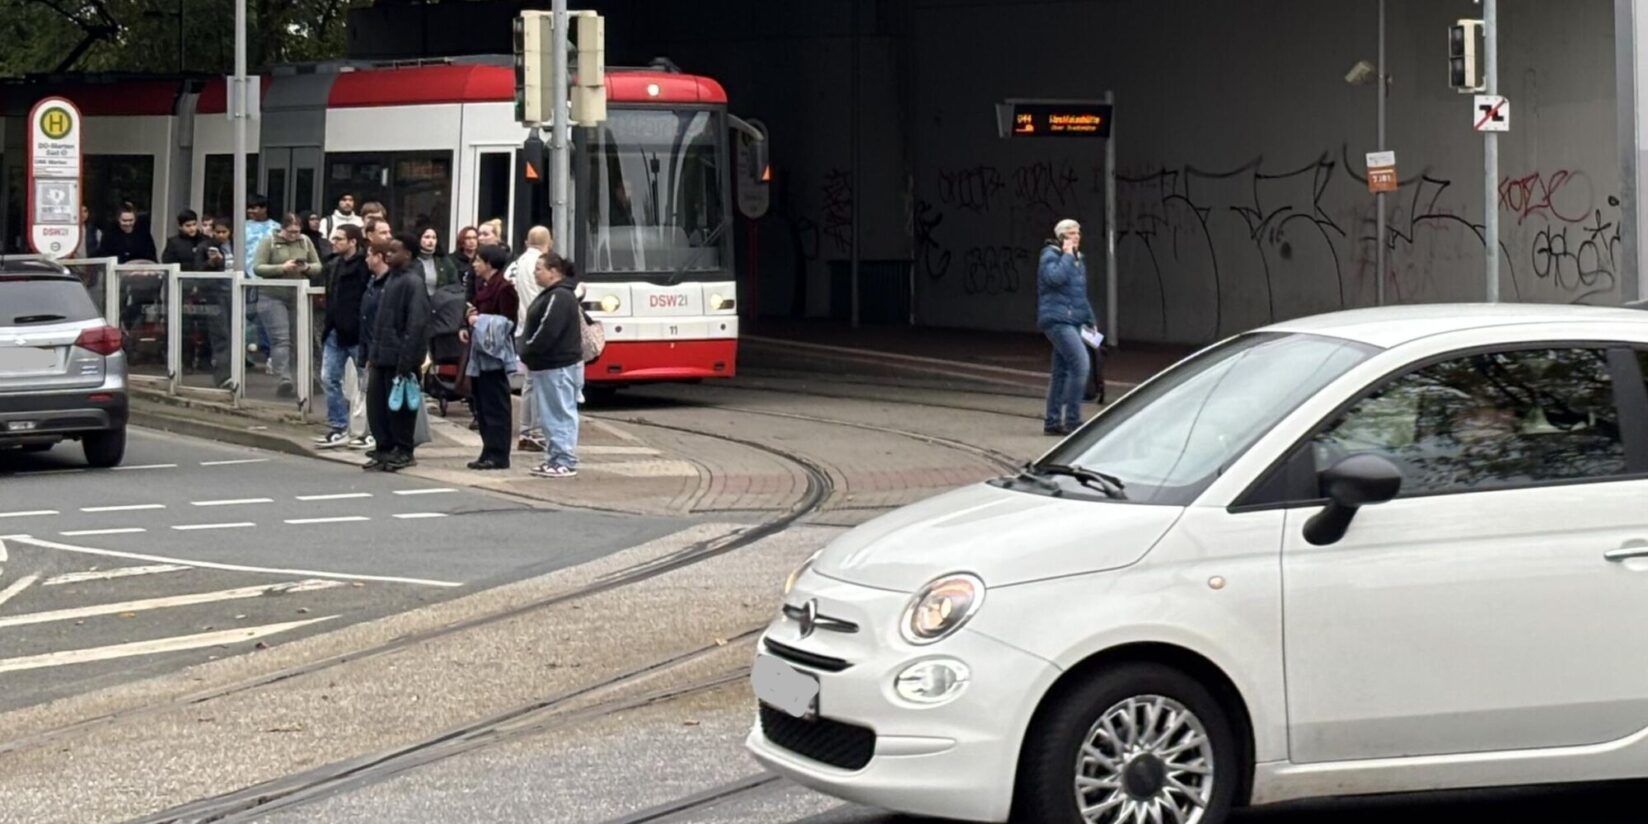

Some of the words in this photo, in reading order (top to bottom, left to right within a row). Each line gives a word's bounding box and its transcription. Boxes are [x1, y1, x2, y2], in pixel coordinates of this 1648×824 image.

[49, 114, 63, 132] H
[649, 294, 688, 307] DSW21
[669, 325, 678, 336] 11
